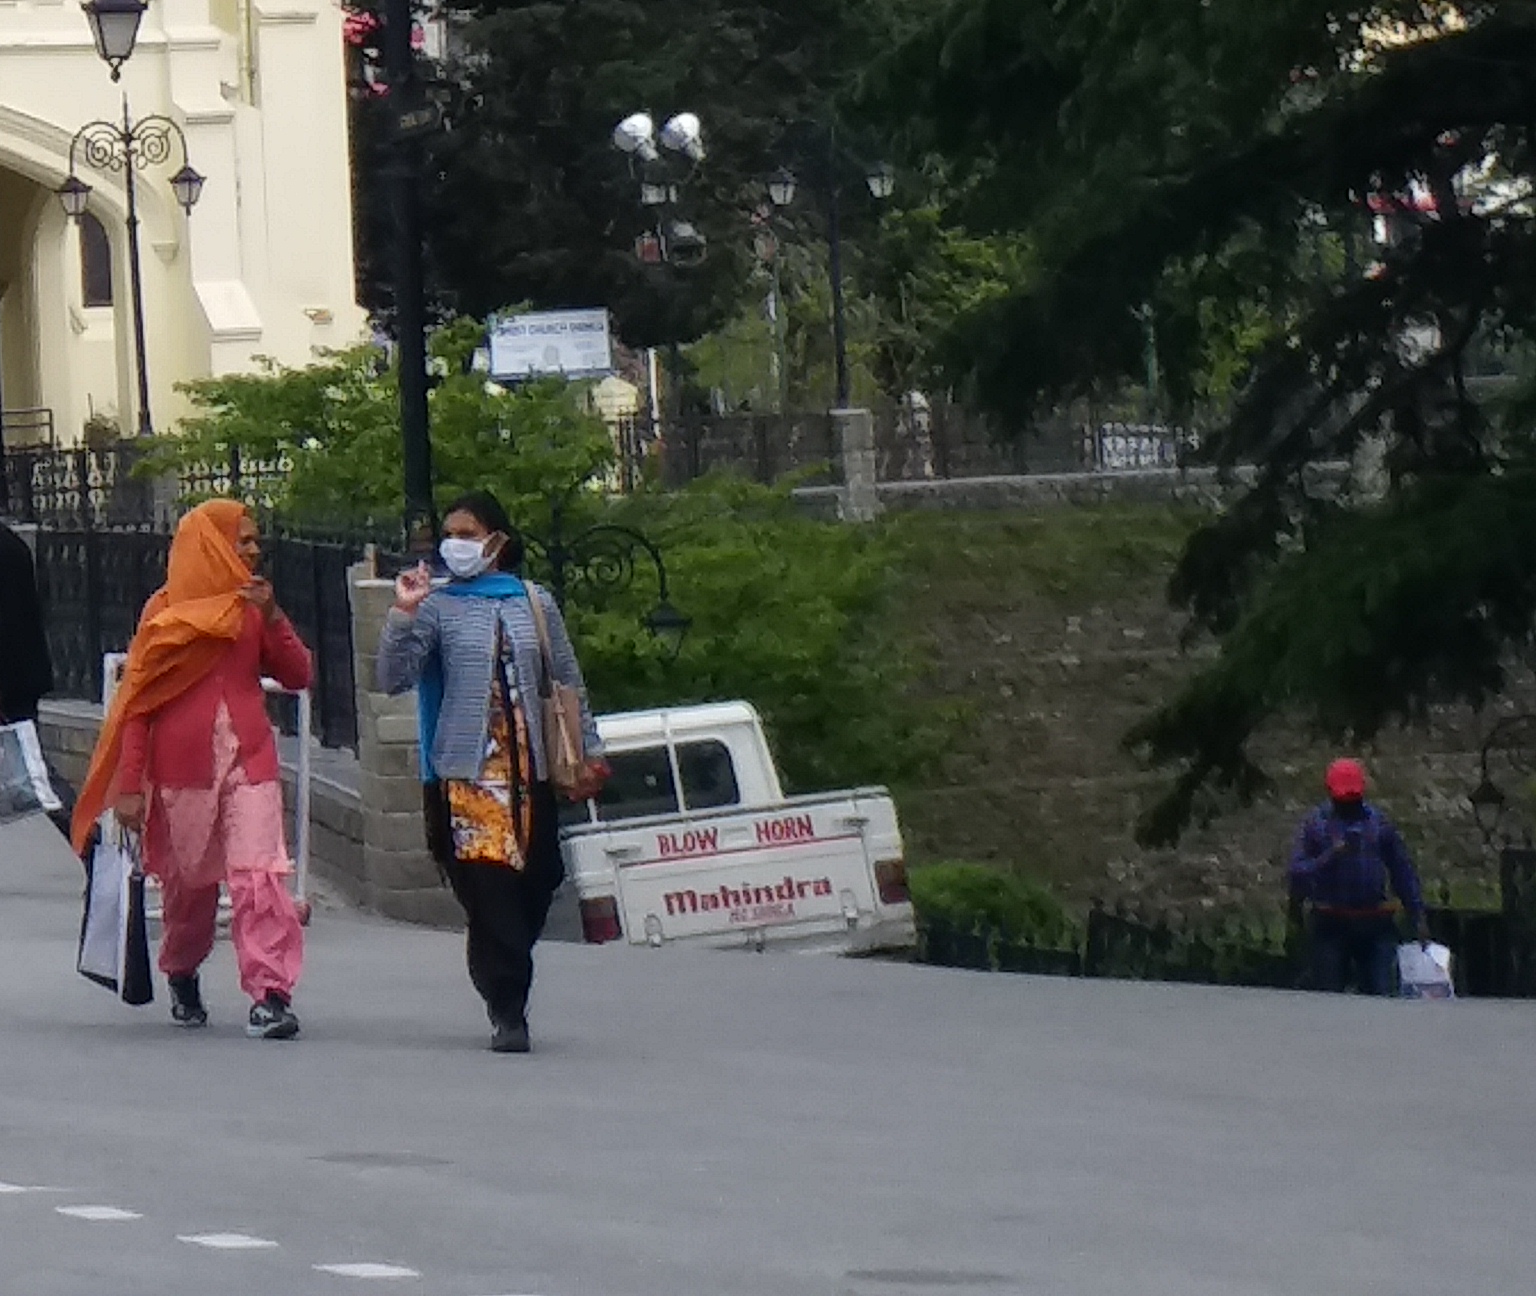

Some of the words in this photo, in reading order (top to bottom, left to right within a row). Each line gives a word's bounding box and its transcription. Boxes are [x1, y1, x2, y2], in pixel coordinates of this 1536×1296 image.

[656, 825, 719, 856] BLOW
[754, 814, 815, 843] HORN
[663, 875, 833, 916] Mahindra
